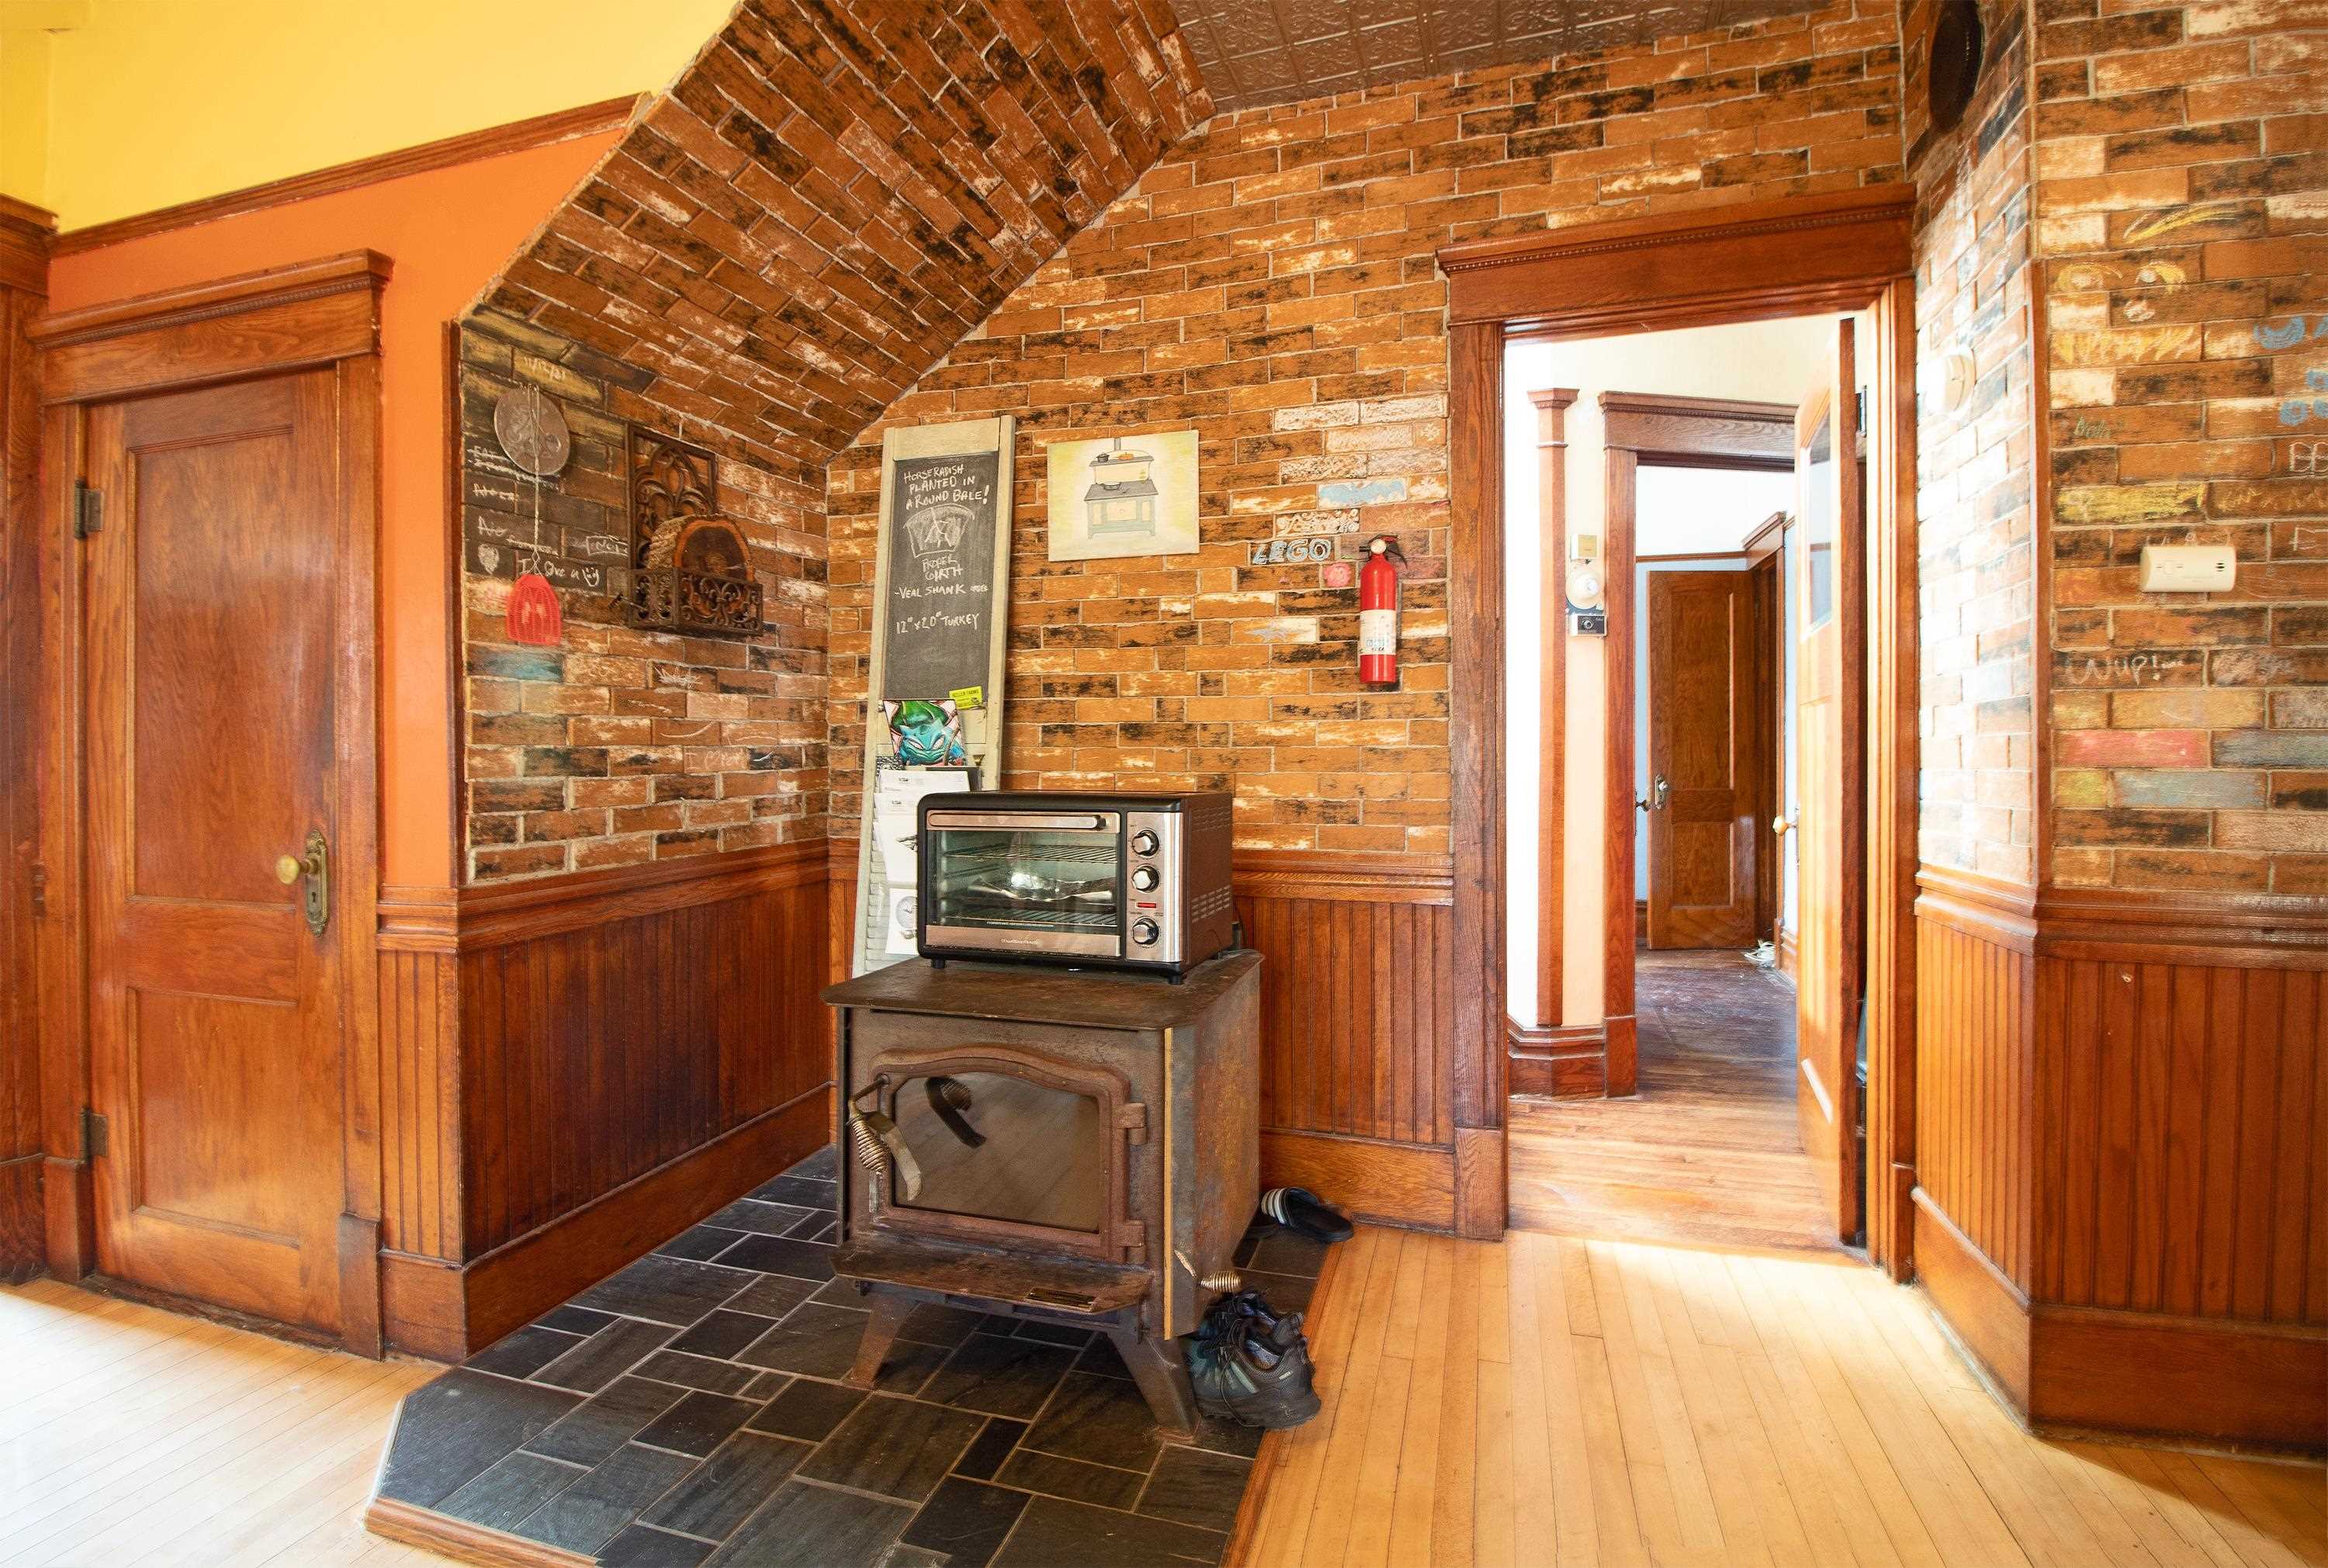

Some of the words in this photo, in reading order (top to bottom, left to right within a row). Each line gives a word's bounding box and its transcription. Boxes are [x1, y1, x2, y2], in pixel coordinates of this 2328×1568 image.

[903, 463, 964, 483] HORSERADISH
[909, 476, 957, 495] PLANTED
[963, 475, 975, 486] IN
[953, 484, 990, 505] BALE!
[1252, 538, 1332, 565] LEGO
[924, 583, 967, 596] SHANK
[940, 613, 979, 631] TURKEY
